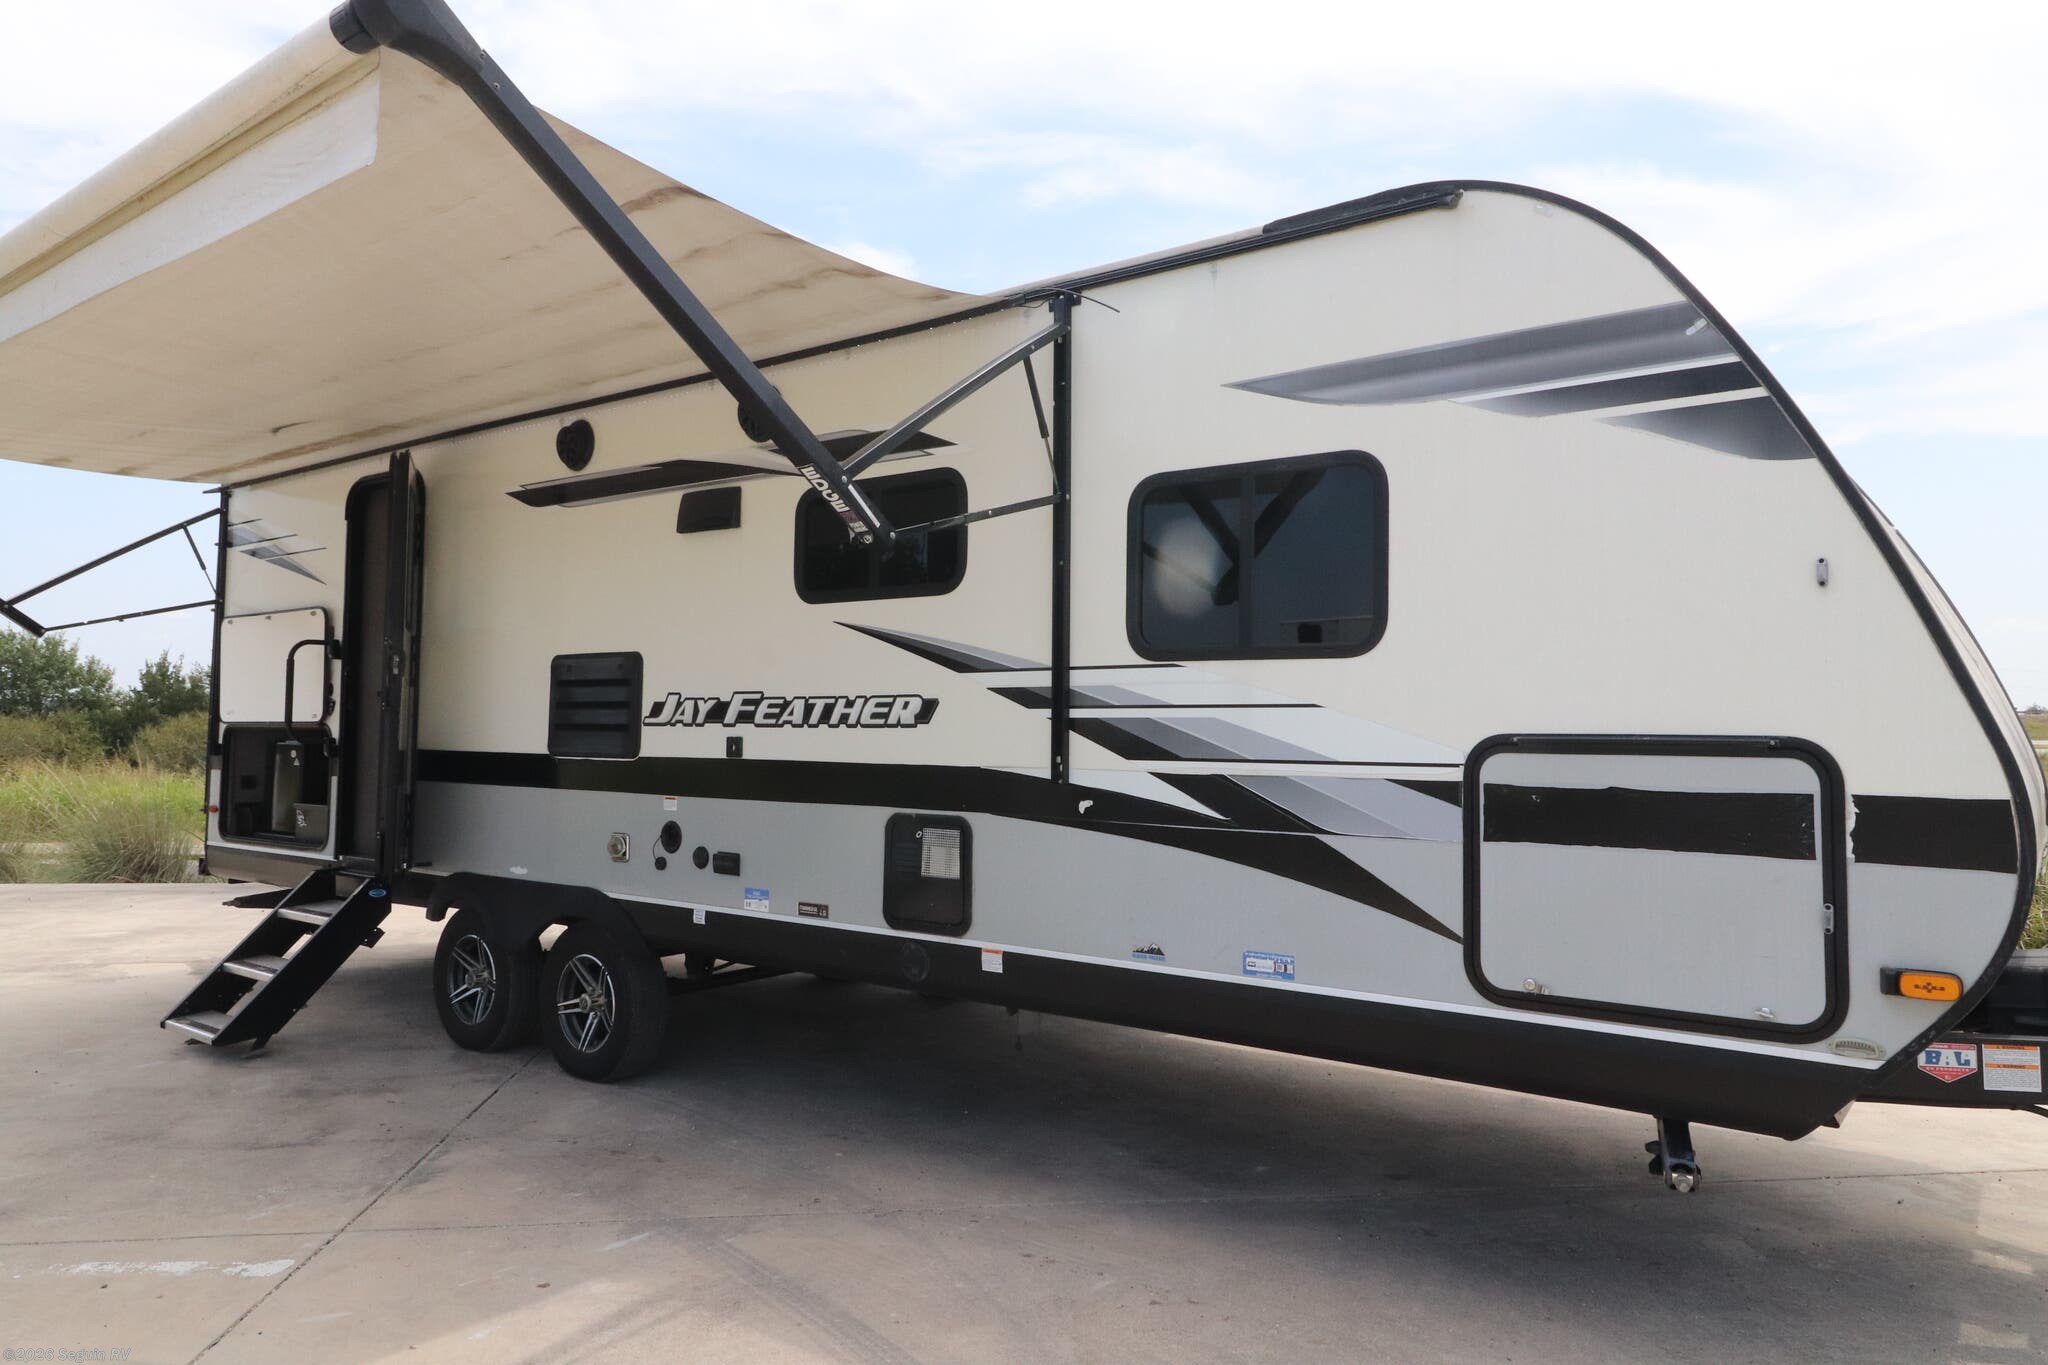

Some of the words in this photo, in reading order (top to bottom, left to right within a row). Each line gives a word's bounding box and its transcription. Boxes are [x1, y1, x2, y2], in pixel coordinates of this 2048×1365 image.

[800, 465, 851, 513] EDGE
[643, 692, 720, 726] JAY
[722, 691, 923, 728] FEATHER
